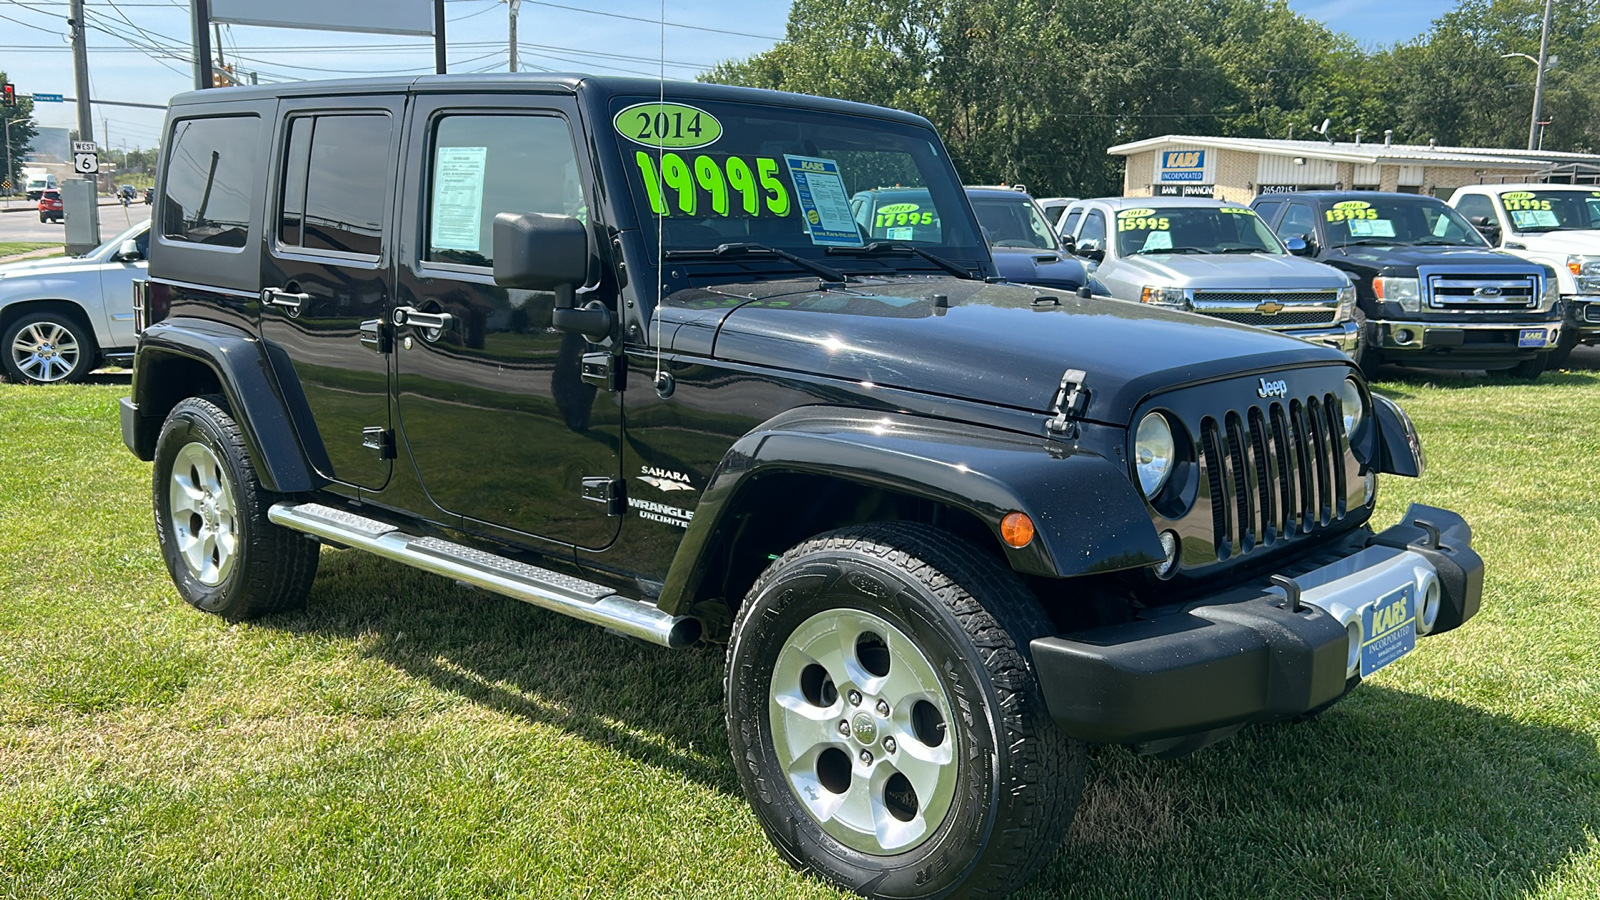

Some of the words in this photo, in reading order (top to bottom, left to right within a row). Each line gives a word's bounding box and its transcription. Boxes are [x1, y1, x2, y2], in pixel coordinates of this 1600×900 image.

[636, 112, 702, 139] 2014
[76, 143, 95, 151] WEST
[82, 158, 91, 170] 6
[801, 161, 825, 171] KARS
[1166, 152, 1200, 168] KARS
[636, 151, 790, 217] 19995
[1162, 172, 1202, 180] INCORPORATED
[1161, 186, 1177, 194] BANK
[1503, 199, 1552, 211] 17995
[875, 212, 933, 228] 17995
[1325, 208, 1378, 222] 13995
[1117, 217, 1170, 232] 15995
[1258, 378, 1287, 399] Jeep
[641, 465, 691, 482] SAHARA
[627, 497, 695, 520] WRANGLE
[639, 510, 690, 528] UNLIMITE
[1372, 597, 1407, 637] KARS
[1368, 625, 1410, 655] INCORPORATED
